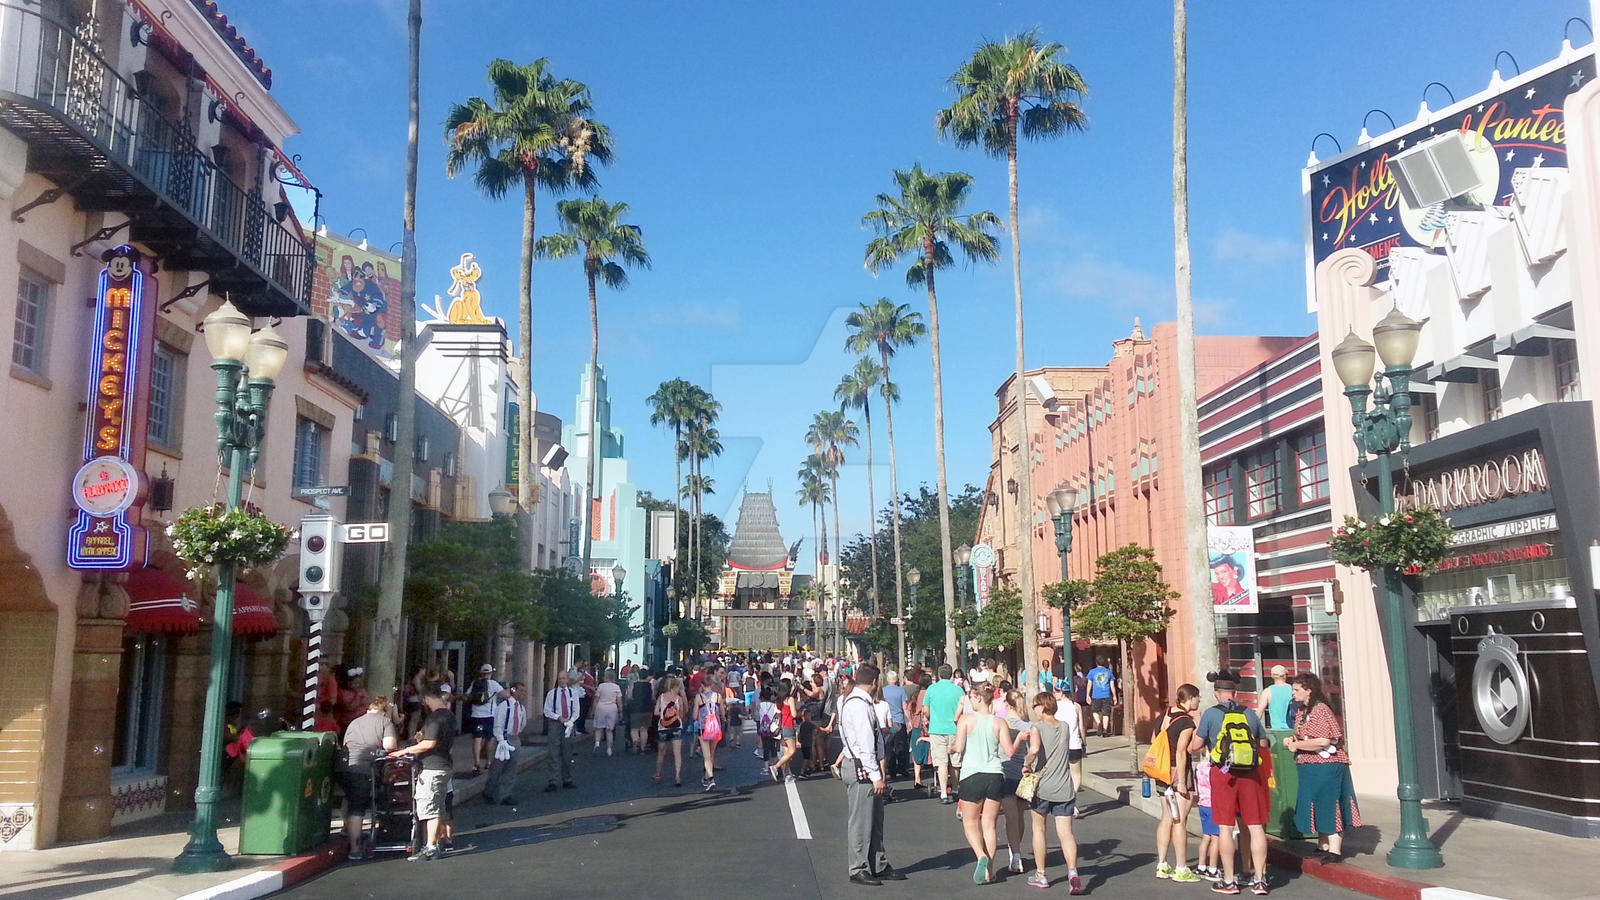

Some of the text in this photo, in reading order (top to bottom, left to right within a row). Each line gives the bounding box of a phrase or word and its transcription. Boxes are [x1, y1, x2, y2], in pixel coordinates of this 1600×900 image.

[1474, 101, 1567, 152] Cantee
[300, 487, 331, 495] PROSPECT
[1413, 449, 1546, 512] DARKROOM
[348, 525, 386, 541] GO
[1504, 516, 1553, 537] SUPPLIES
